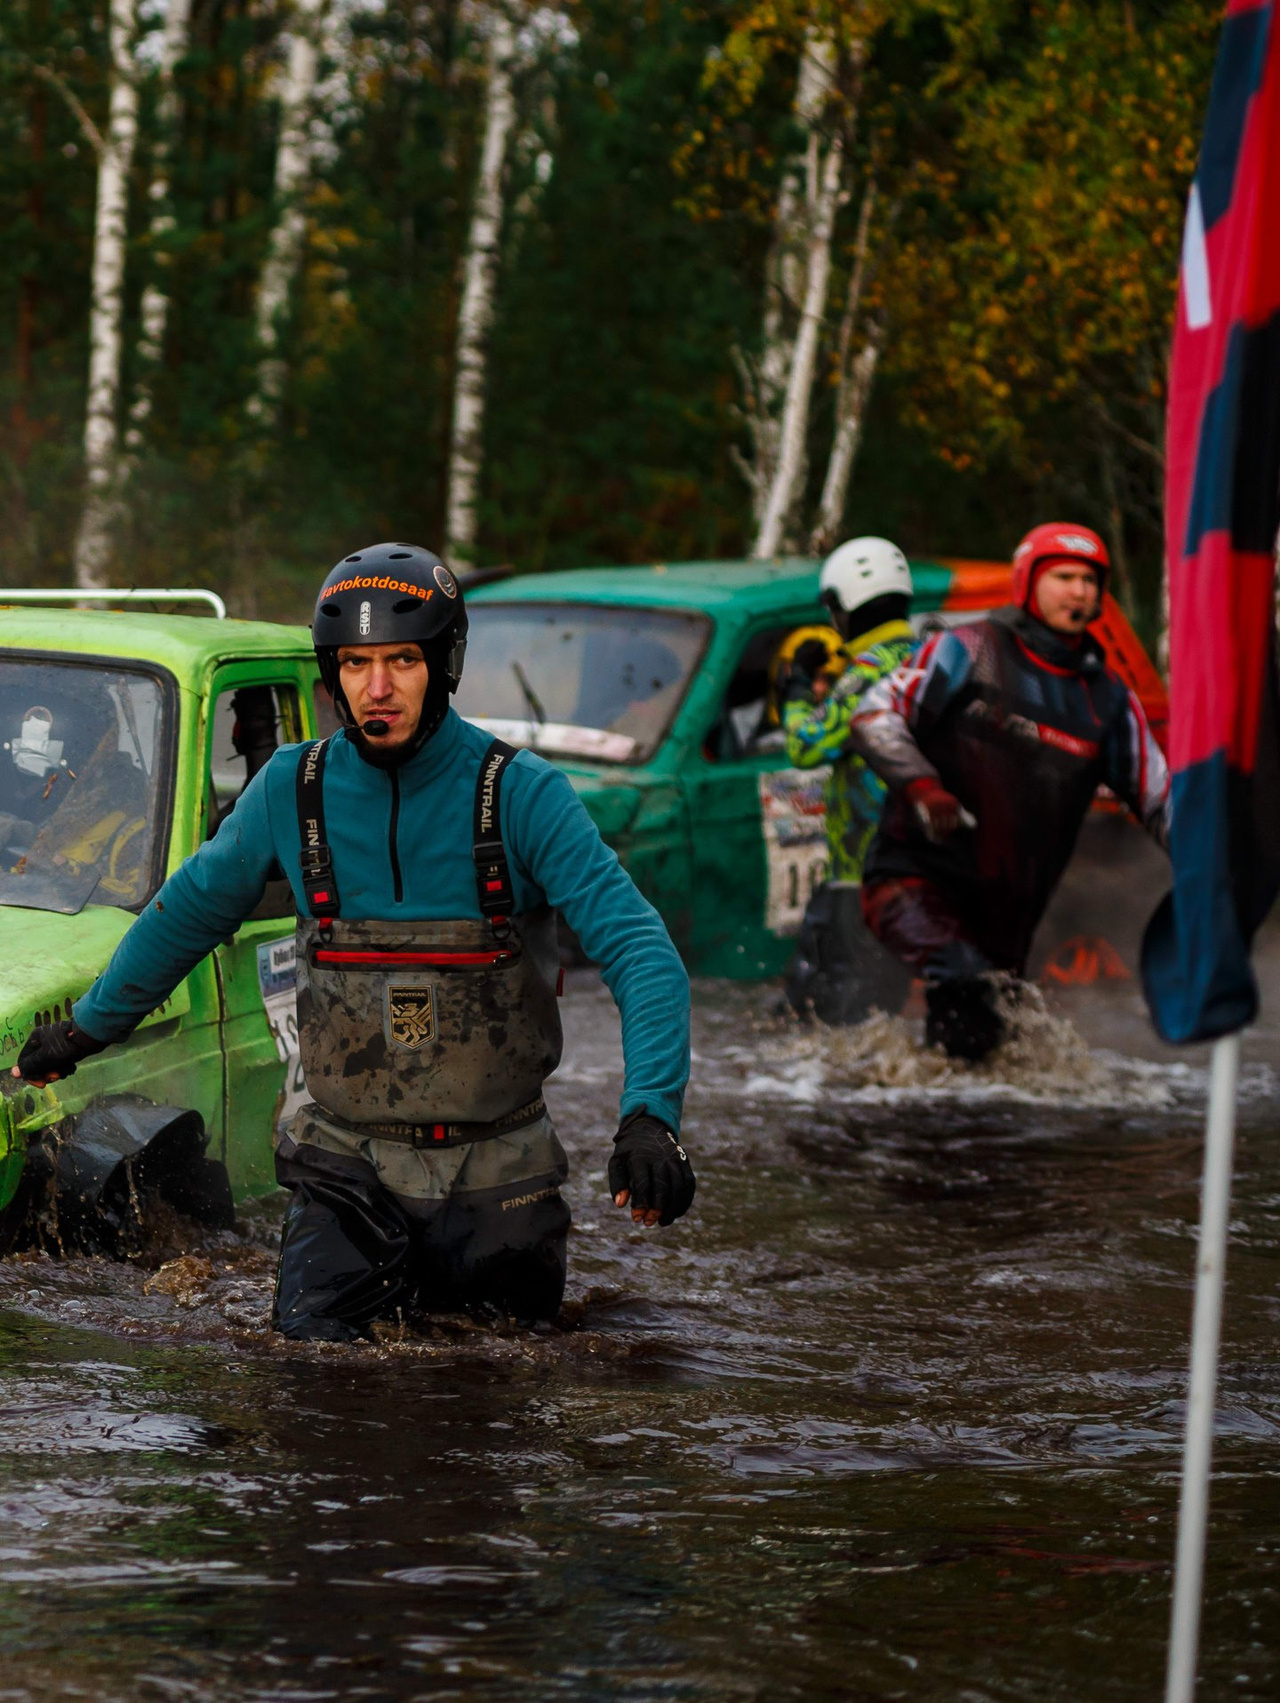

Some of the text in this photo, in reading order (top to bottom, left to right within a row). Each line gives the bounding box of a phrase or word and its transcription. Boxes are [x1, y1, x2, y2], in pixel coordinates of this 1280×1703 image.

[320, 575, 434, 602] #avtokotdosaaf
[304, 742, 323, 784] TRAIL
[481, 754, 505, 833] FINNTRAIL
